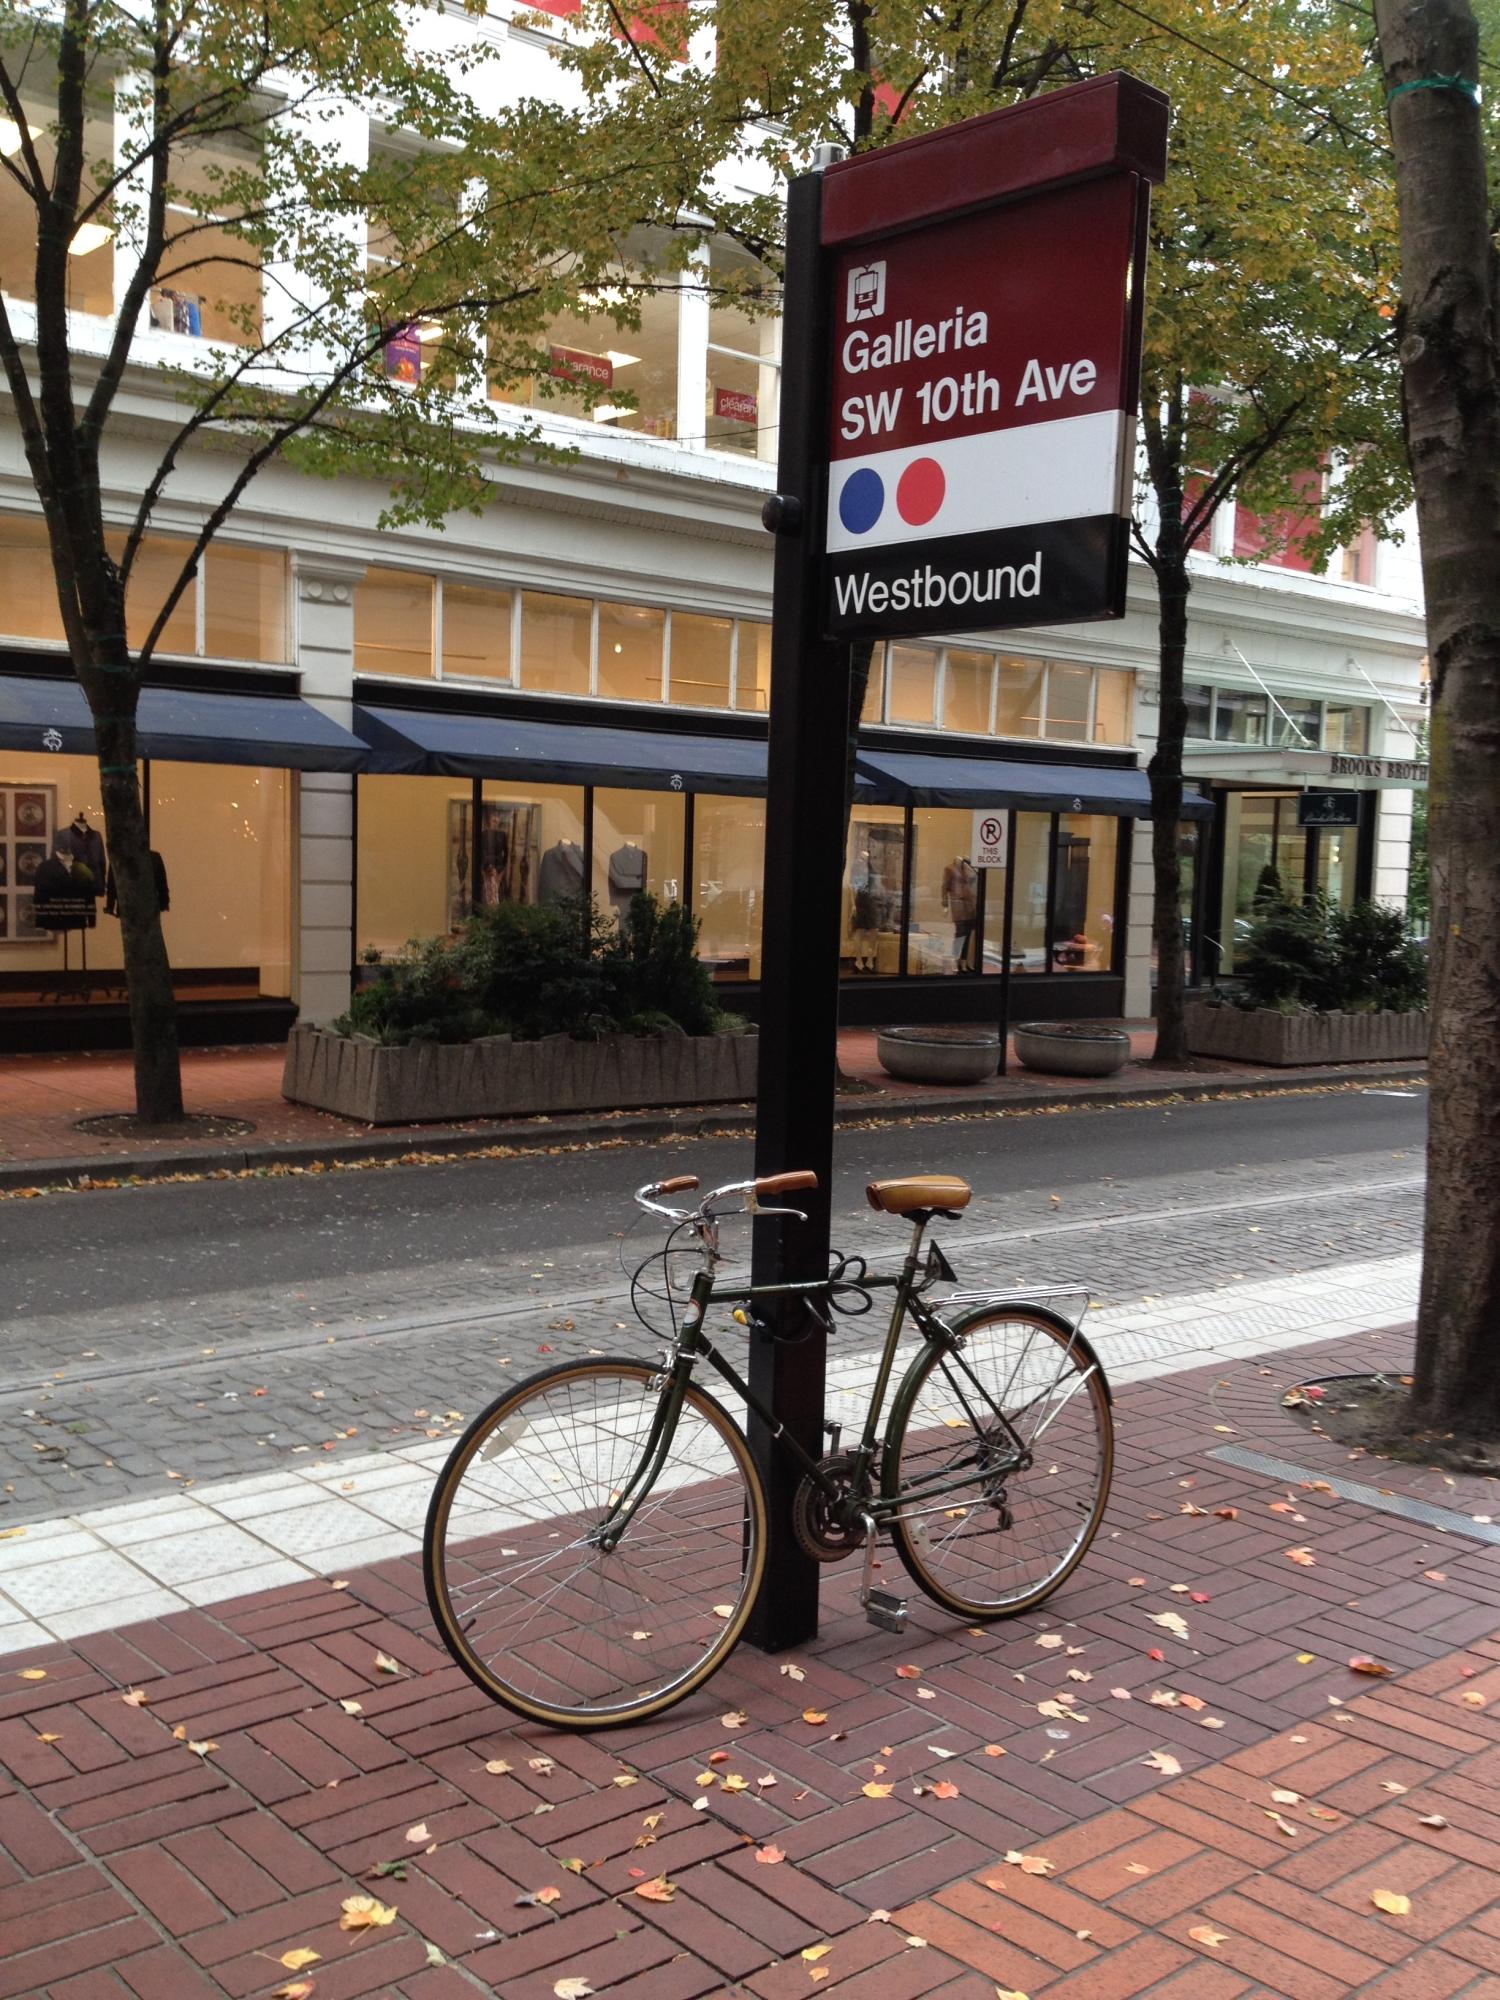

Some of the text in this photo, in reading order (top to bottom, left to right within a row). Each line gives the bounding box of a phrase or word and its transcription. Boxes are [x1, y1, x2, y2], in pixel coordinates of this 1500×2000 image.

[842, 306, 989, 374] Galleria
[840, 358, 1098, 440] SW 10th Ave
[834, 551, 1043, 616] Westbound
[1331, 756, 1382, 777] BROOKS
[977, 855, 1002, 864] BLOCK
[982, 847, 999, 855] THIS
